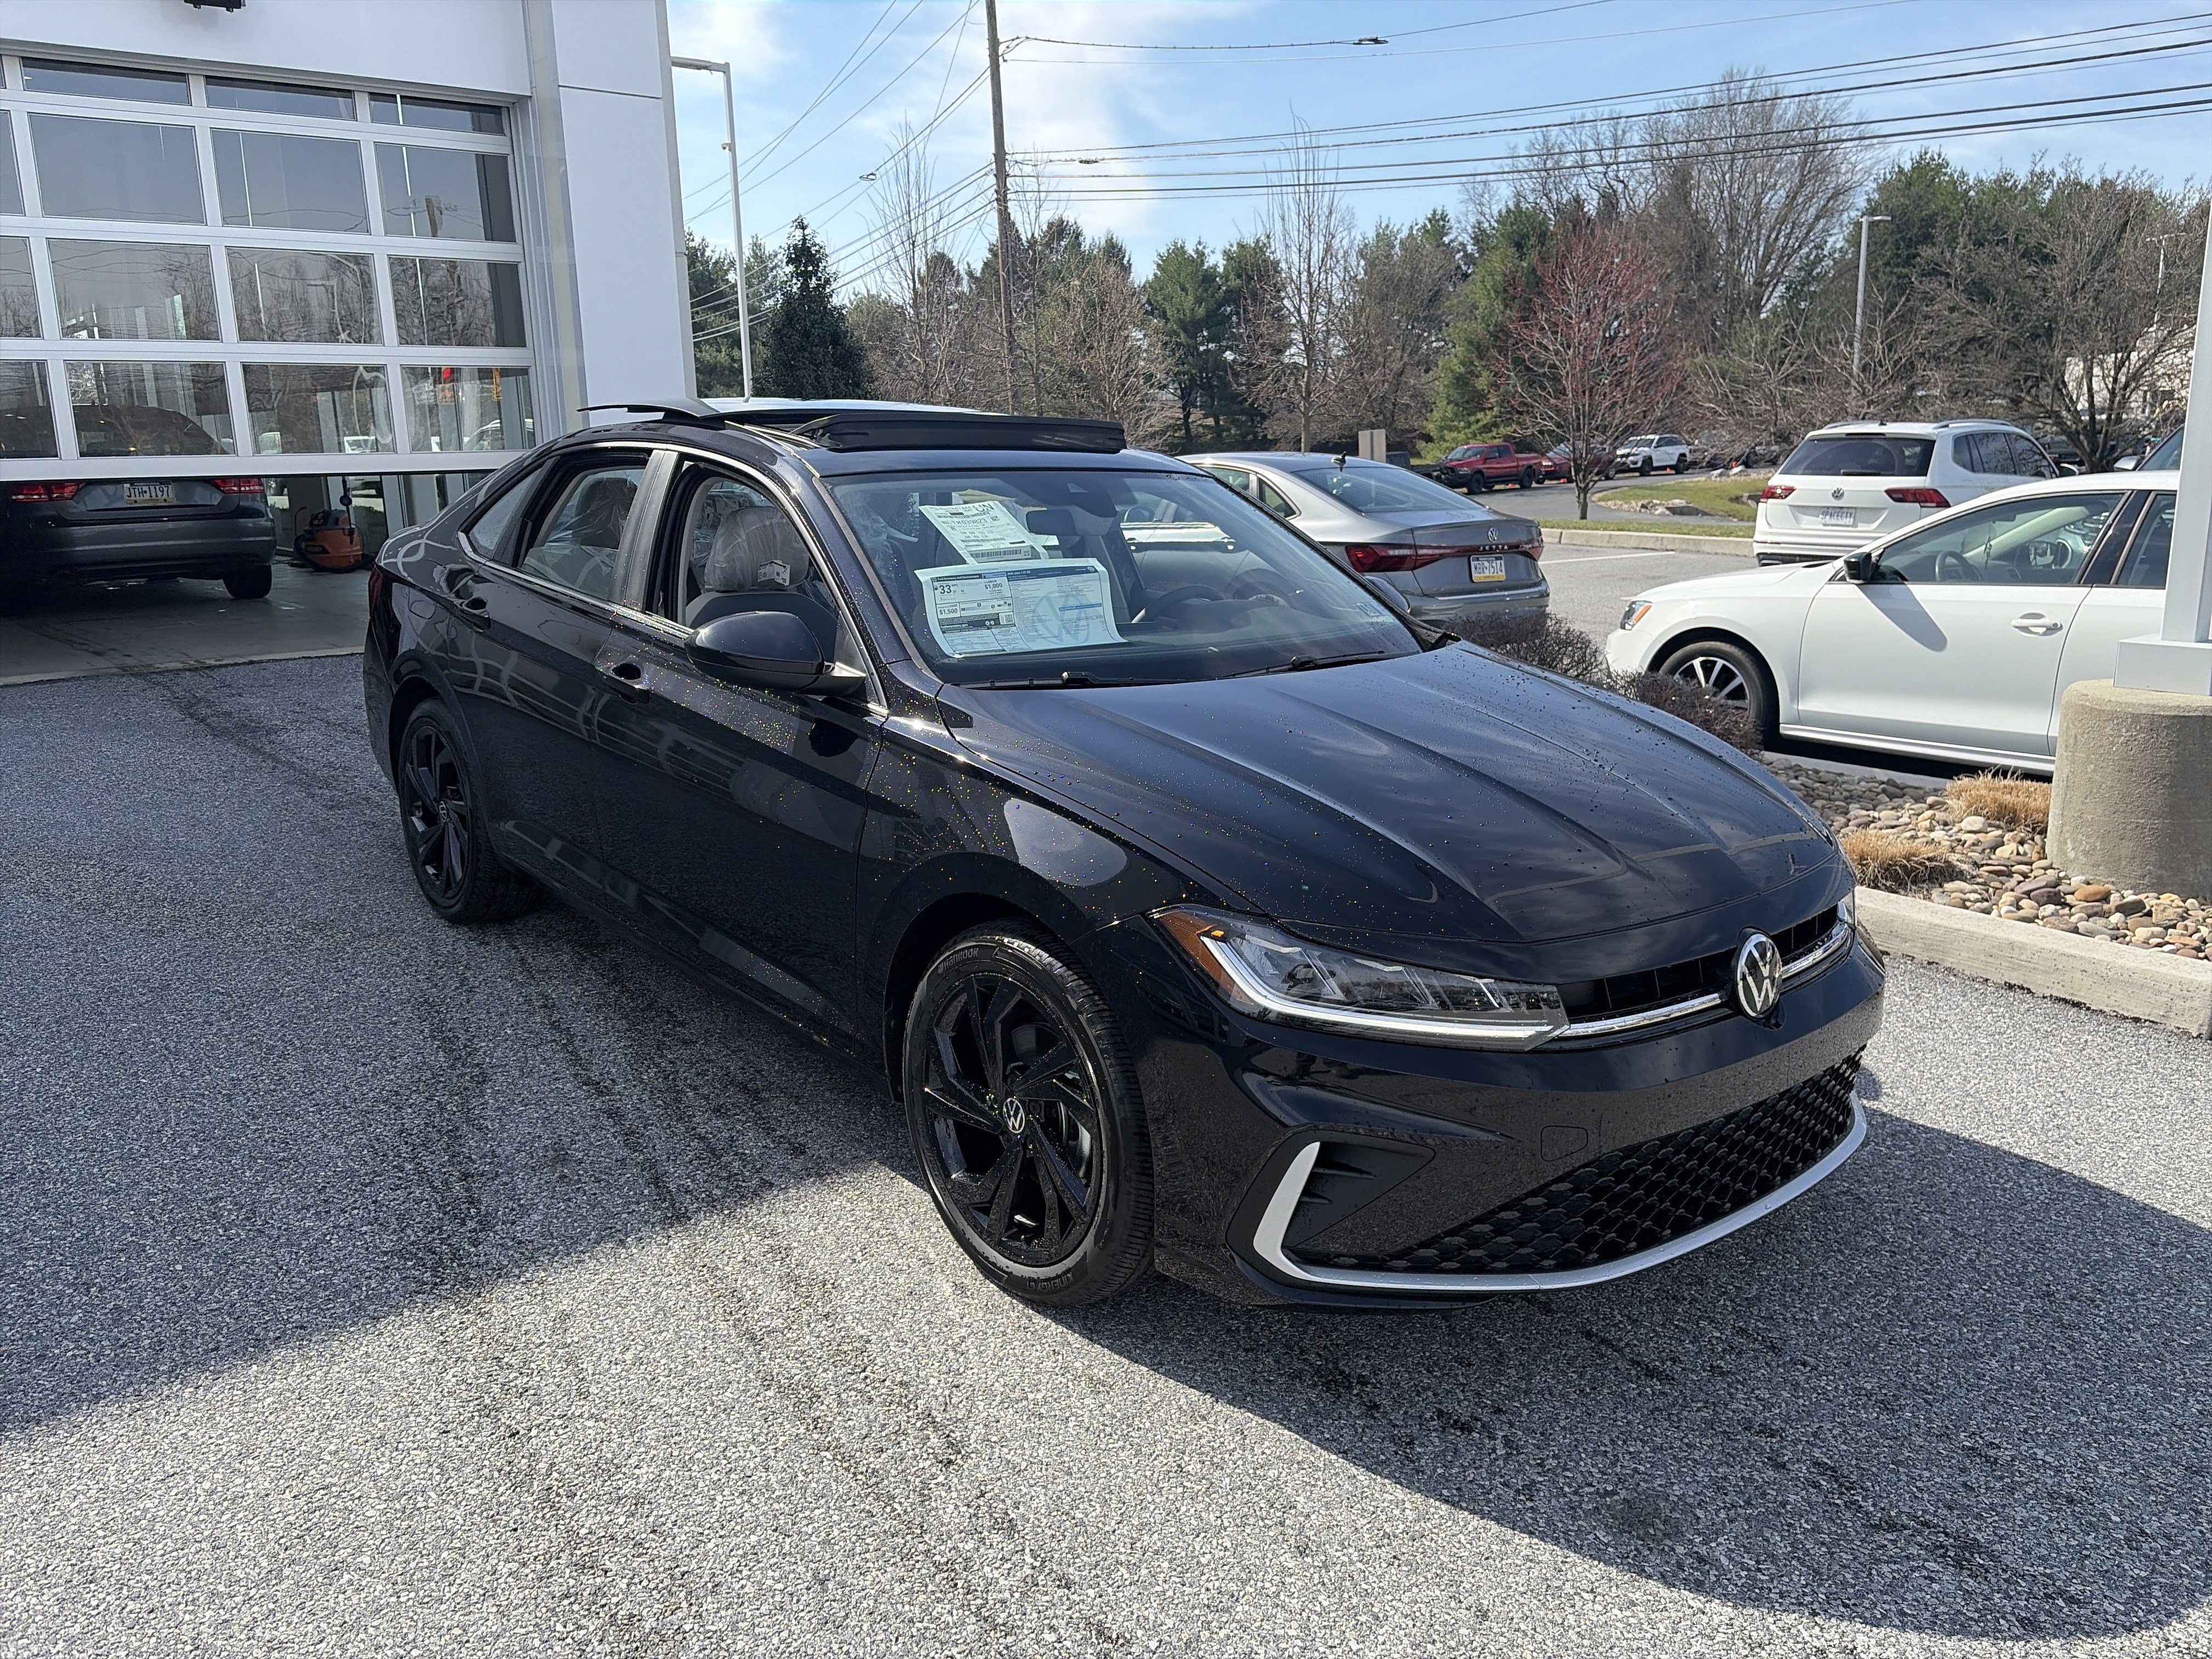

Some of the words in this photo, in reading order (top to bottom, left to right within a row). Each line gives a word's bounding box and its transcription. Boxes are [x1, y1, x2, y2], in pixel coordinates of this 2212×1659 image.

[939, 584, 952, 594] 33
[1736, 932, 1782, 1018] VW
[1003, 1098, 1025, 1133] VW
